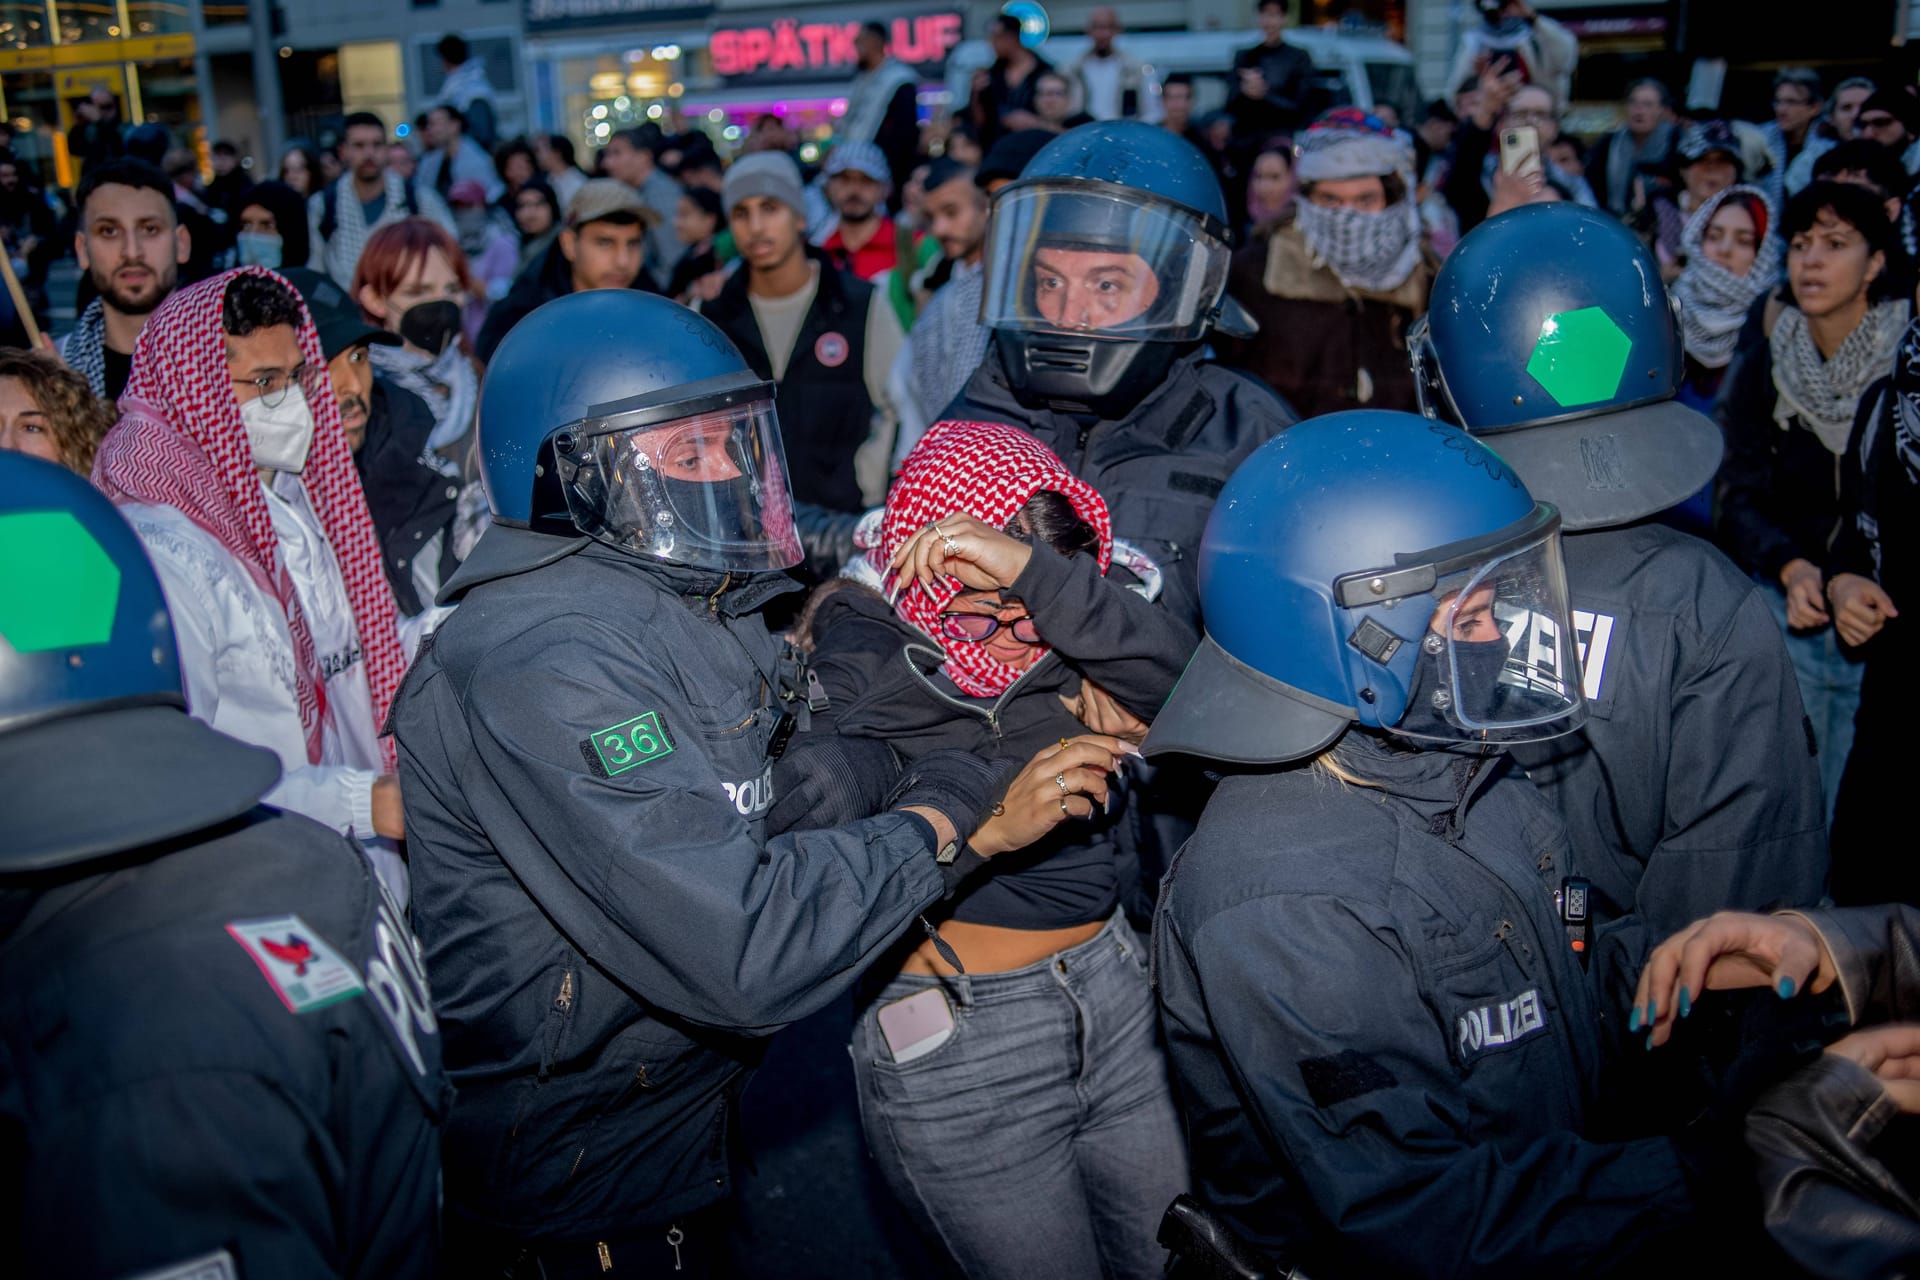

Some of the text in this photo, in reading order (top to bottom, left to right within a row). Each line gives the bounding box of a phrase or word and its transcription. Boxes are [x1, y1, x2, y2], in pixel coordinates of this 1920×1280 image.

[709, 14, 962, 75] SPÄTKUF
[603, 723, 660, 764] 36
[1459, 989, 1544, 1059] POLIZEI
